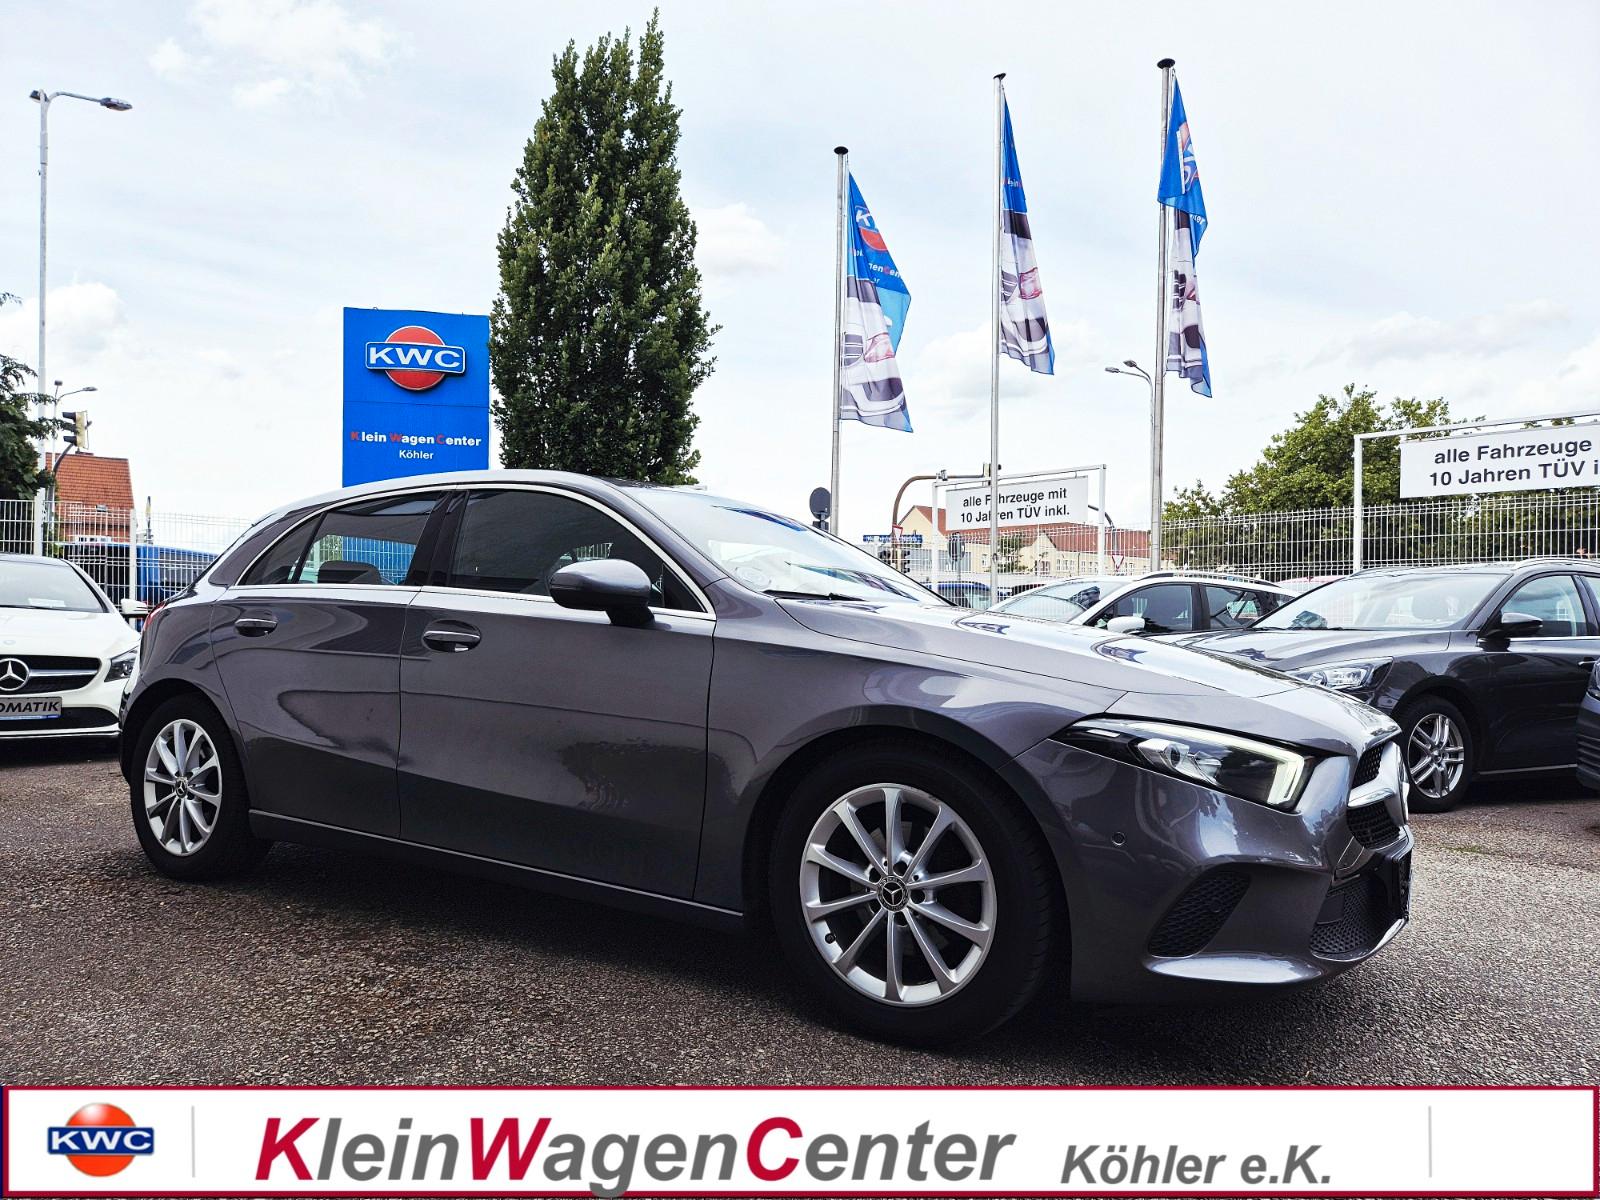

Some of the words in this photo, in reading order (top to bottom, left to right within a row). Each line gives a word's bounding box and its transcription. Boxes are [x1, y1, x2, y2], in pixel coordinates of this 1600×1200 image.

[369, 346, 460, 368] KWC
[399, 449, 434, 460] Köhler
[1434, 448, 1470, 465] alle
[1477, 439, 1592, 461] Fahrzeuge
[1429, 471, 1451, 486] 10
[1458, 467, 1531, 485] Jahren
[1538, 458, 1586, 479] TÜV
[963, 495, 982, 507] alle
[985, 490, 1045, 505] Fhrzeuge
[1048, 488, 1068, 500] mit
[961, 512, 973, 523] 10
[1017, 504, 1042, 519] TÜV
[1045, 504, 1071, 517] inkl.
